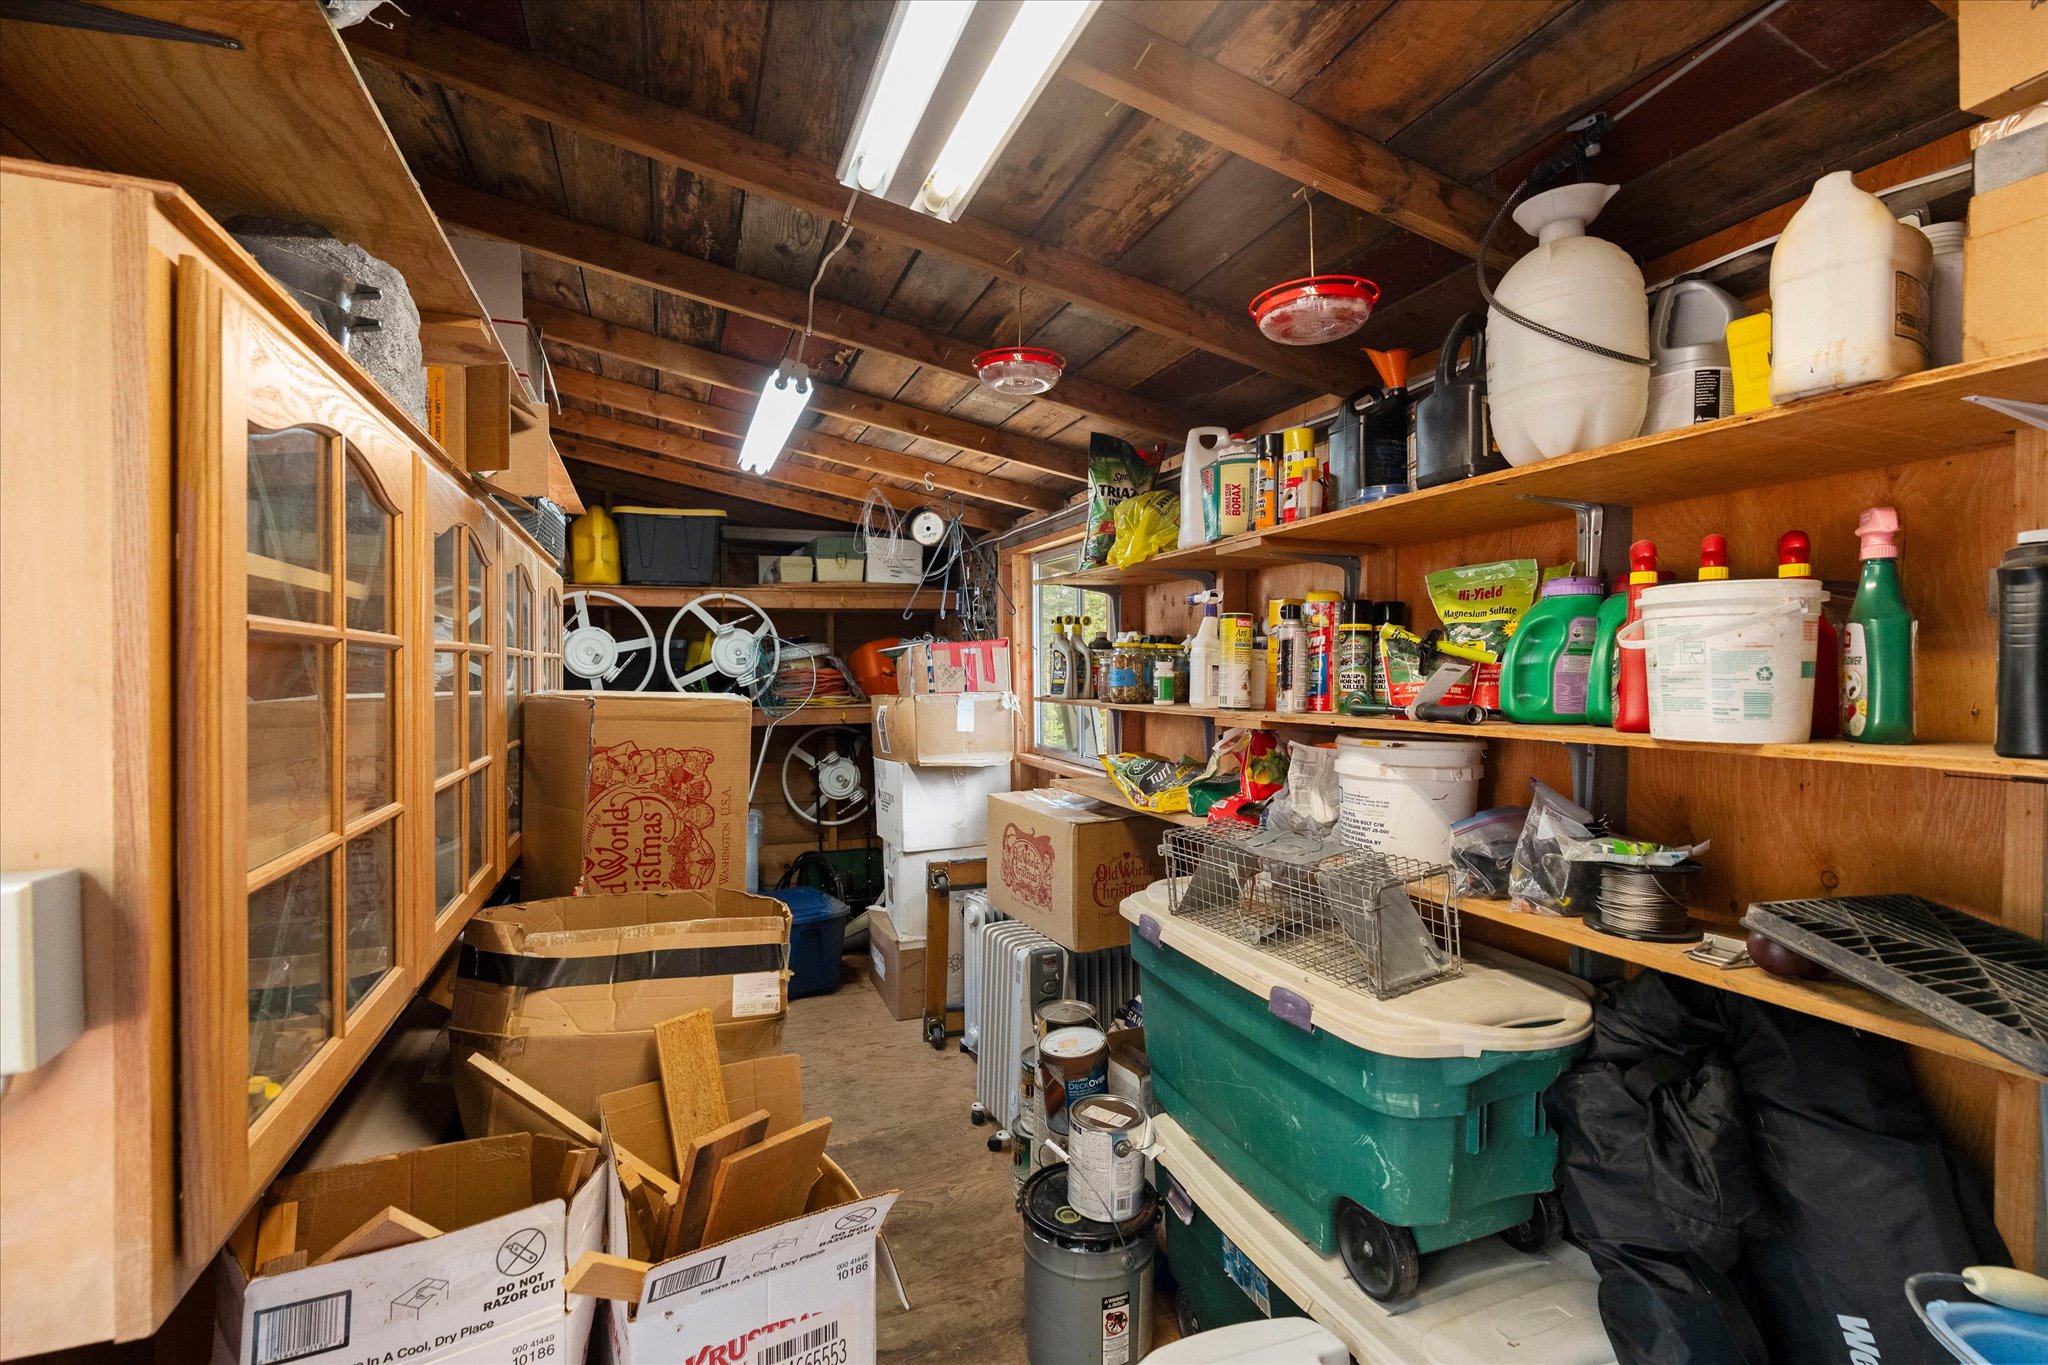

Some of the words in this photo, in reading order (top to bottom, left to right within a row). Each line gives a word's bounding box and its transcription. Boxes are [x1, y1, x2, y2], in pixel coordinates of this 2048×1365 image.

[1231, 483, 1242, 517] BORAX
[1458, 585, 1504, 601] Hi-Yield
[1443, 609, 1488, 620] Magnesium
[1489, 606, 1518, 616] Sulfate
[1147, 763, 1172, 785] Turf
[720, 786, 732, 817] U.S.A.
[1354, 836, 1373, 844] CANADA
[718, 822, 730, 886] WASHINGTON
[817, 1234, 855, 1248] RAZOR
[855, 1225, 877, 1238] CUT
[829, 1230, 847, 1240] DO
[848, 1223, 870, 1235] NOT
[700, 1282, 729, 1296] Store
[730, 1278, 741, 1286] In
[779, 1258, 798, 1271] Dry
[799, 1248, 827, 1263] Place
[836, 1260, 849, 1270] 000
[836, 1261, 869, 1281] 10186
[483, 1289, 529, 1312] RAZOR
[531, 1278, 556, 1295] CUT
[496, 1282, 515, 1297] DO
[519, 1271, 545, 1289] NOT
[382, 1350, 395, 1365] A
[397, 1341, 432, 1360] Cool,
[434, 1331, 458, 1351] Dry
[460, 1319, 495, 1341] Place
[511, 1343, 528, 1356] 000
[530, 1334, 555, 1349] 41449
[512, 1343, 556, 1365] 10186
